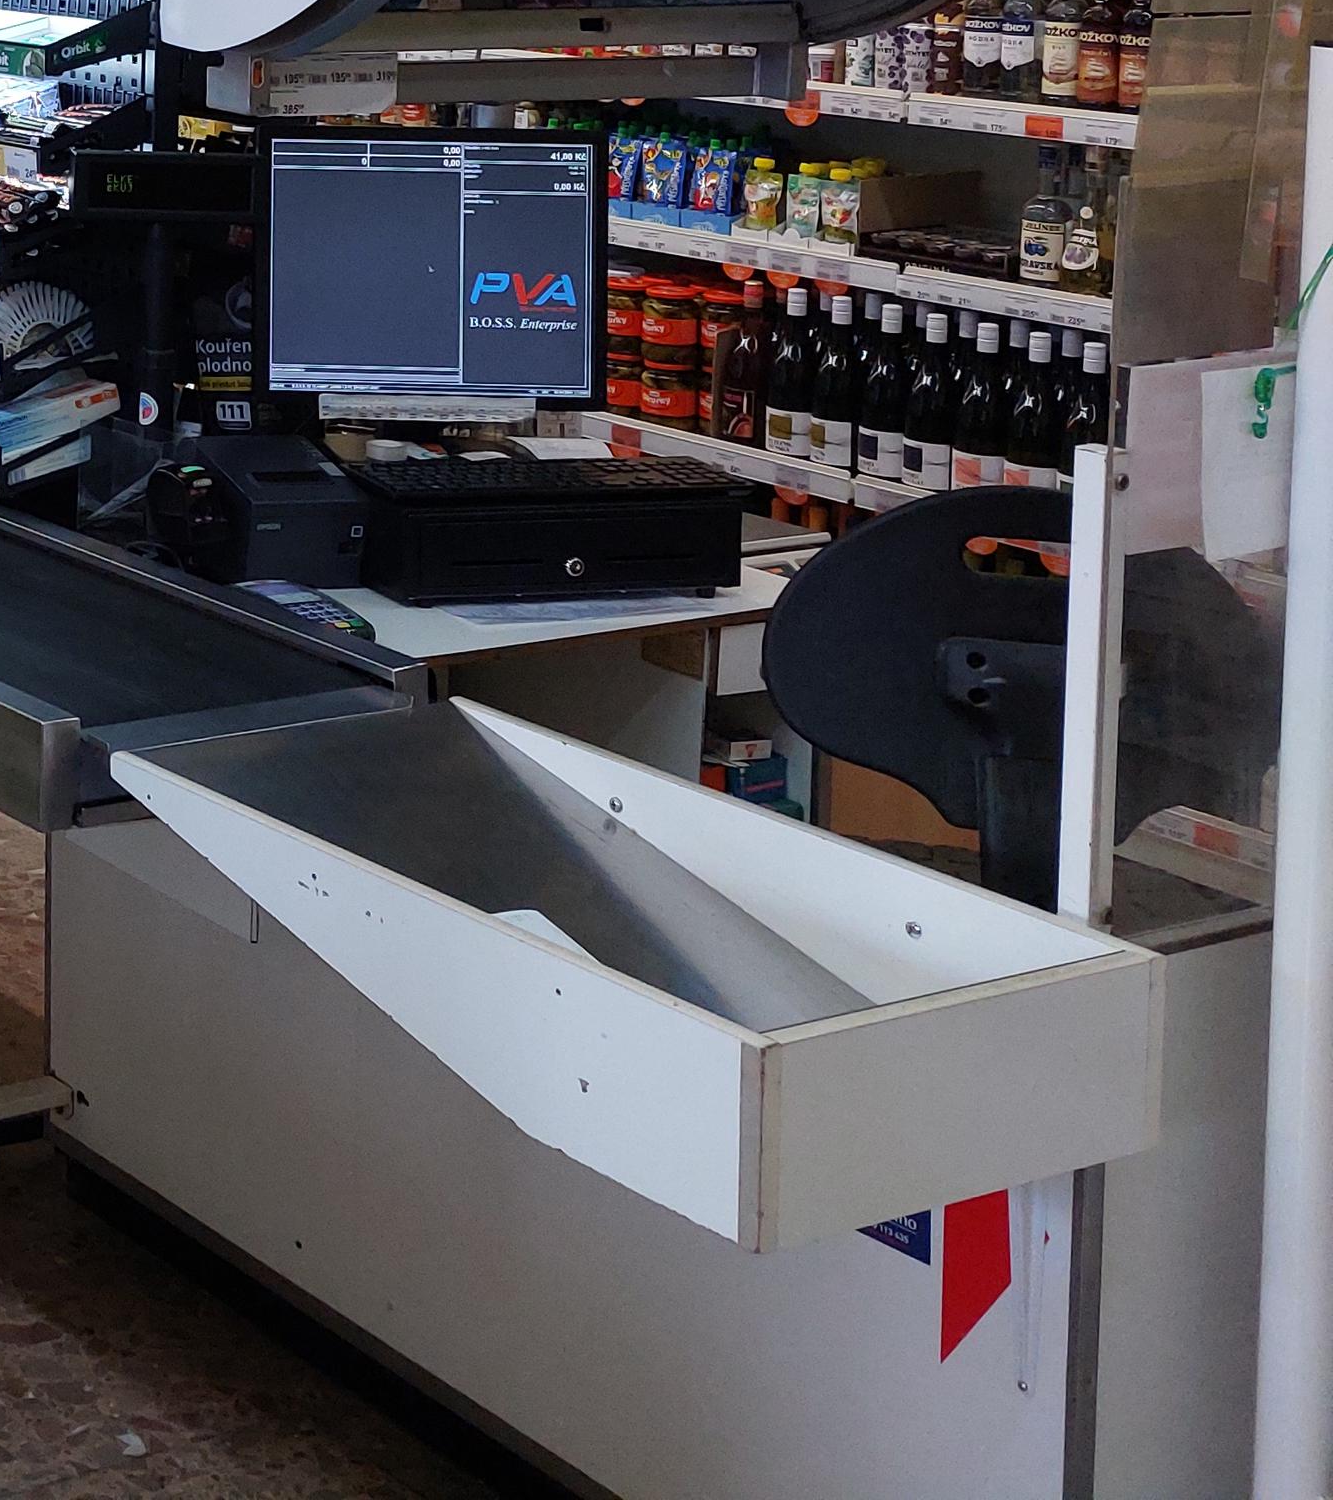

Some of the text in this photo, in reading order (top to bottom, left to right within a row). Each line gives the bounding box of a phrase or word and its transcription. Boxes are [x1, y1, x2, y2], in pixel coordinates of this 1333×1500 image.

[61, 40, 92, 60] Orbit
[470, 272, 577, 307] PVA
[469, 316, 578, 334] B.O.S.S. Enterprise
[220, 403, 245, 420] 111
